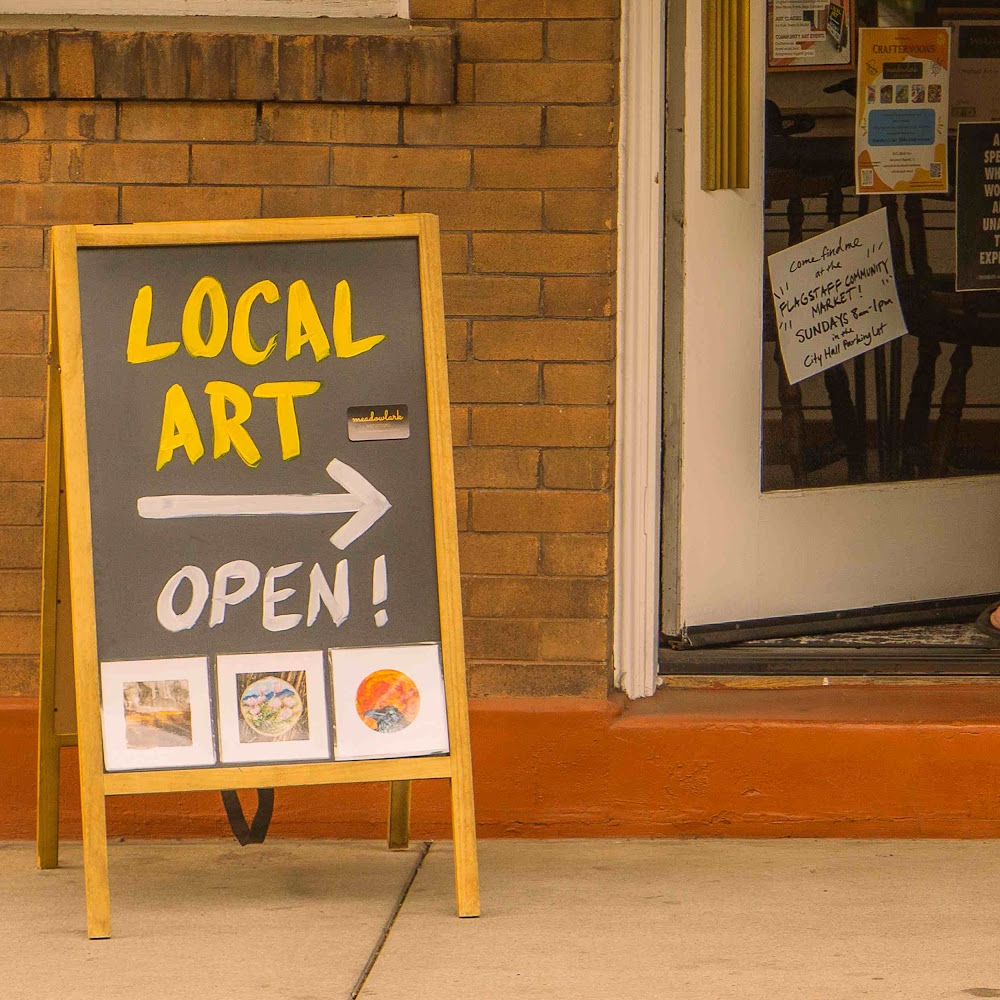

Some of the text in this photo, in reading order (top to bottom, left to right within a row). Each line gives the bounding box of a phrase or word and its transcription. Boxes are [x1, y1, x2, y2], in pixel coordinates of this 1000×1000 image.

[872, 44, 936, 54] CRAFTERNOONS
[789, 236, 863, 273] Come find me
[815, 260, 842, 278] at the
[779, 258, 889, 317] FLAGSTAFF COMMUNITY
[126, 276, 387, 366] LOCAL
[795, 313, 849, 343] SUNDAYS
[832, 328, 855, 341] in the
[803, 323, 888, 367] City Hall Parking Lot
[156, 381, 321, 471] ART
[351, 409, 405, 423] meadowlark
